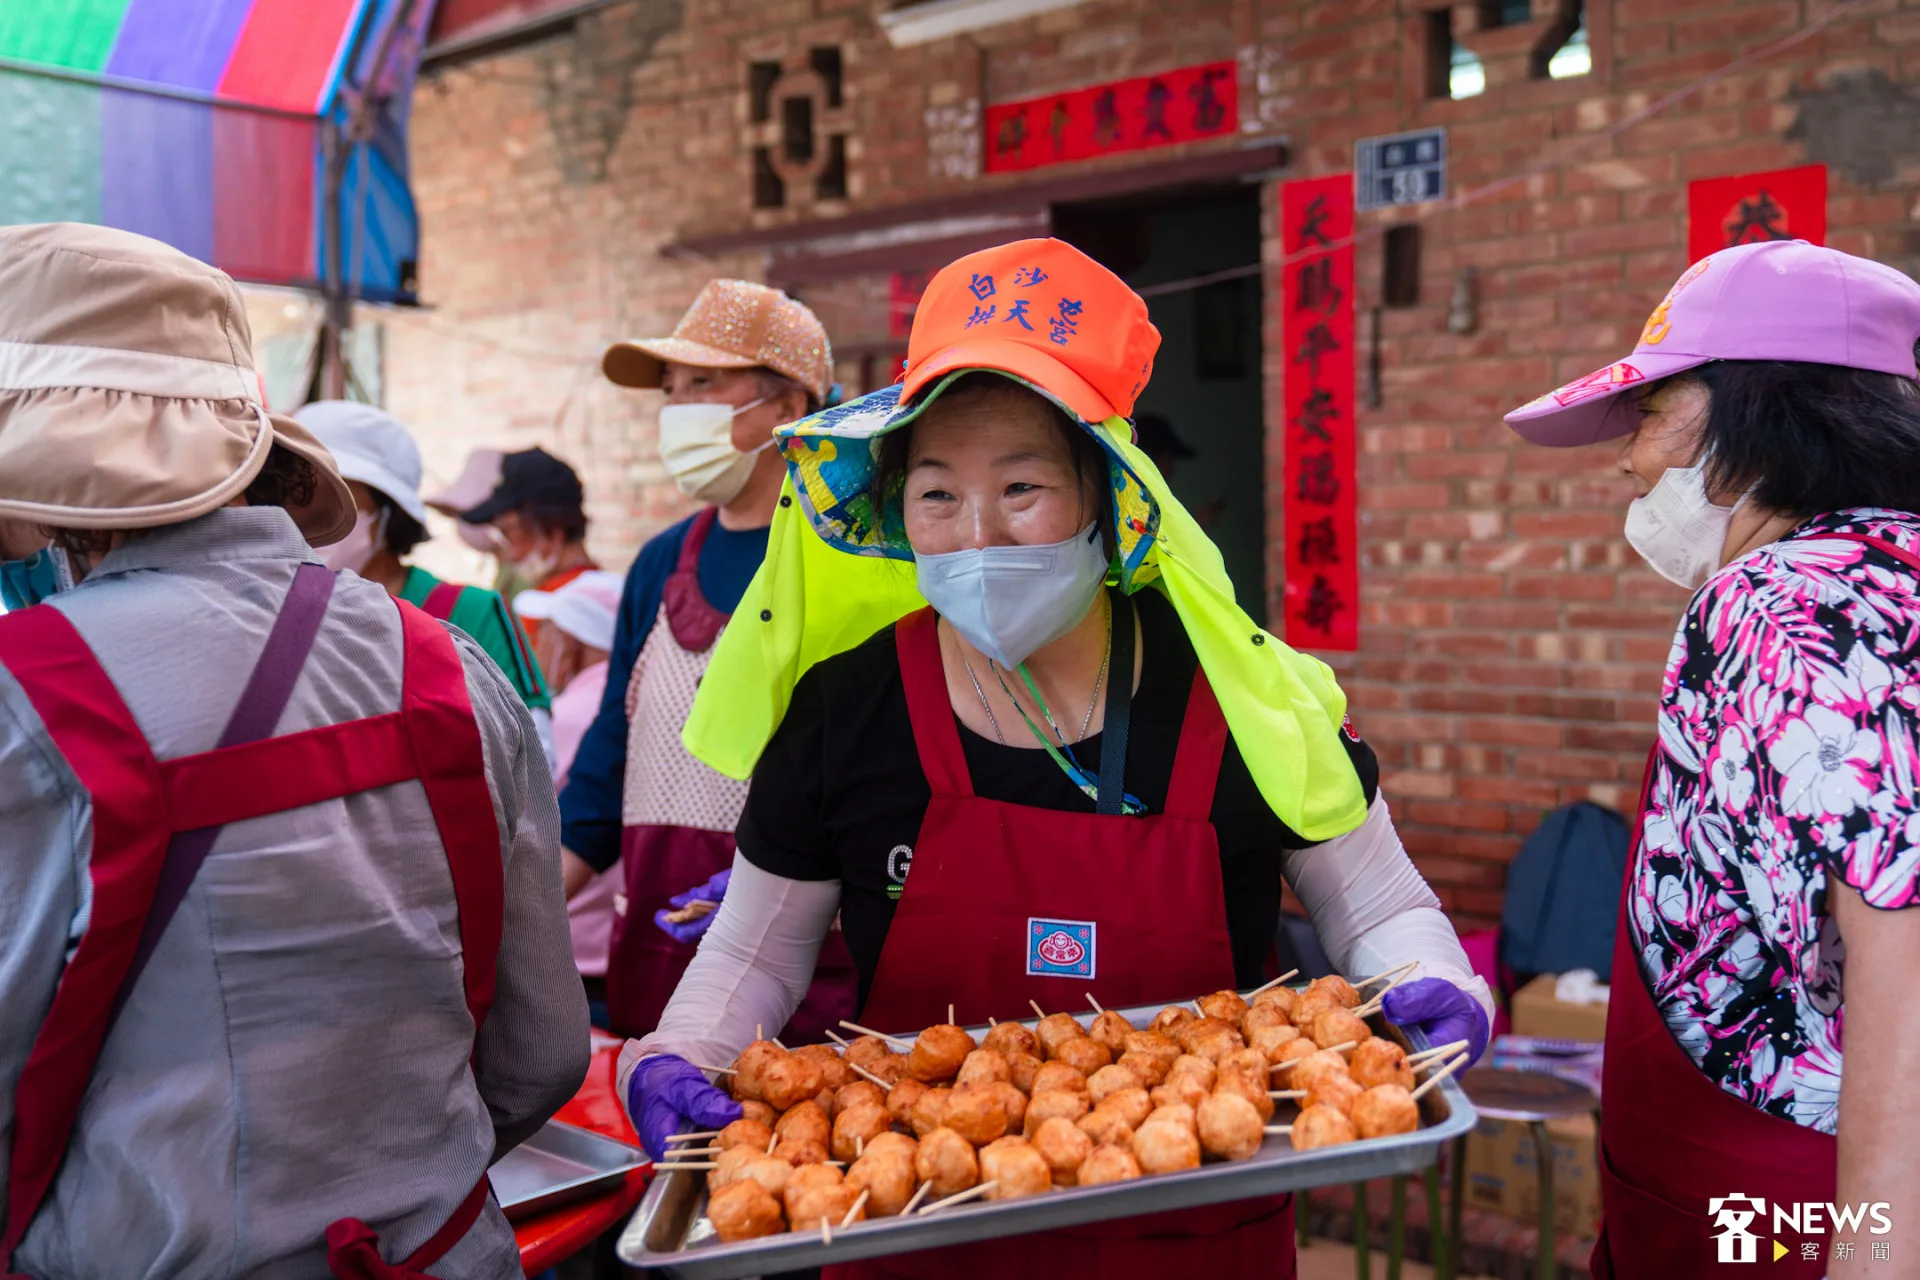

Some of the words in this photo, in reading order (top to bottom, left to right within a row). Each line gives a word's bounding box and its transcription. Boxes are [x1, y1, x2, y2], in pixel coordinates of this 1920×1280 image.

[964, 299, 1077, 346] 拱天宮
[968, 267, 1083, 326] 白沙屯
